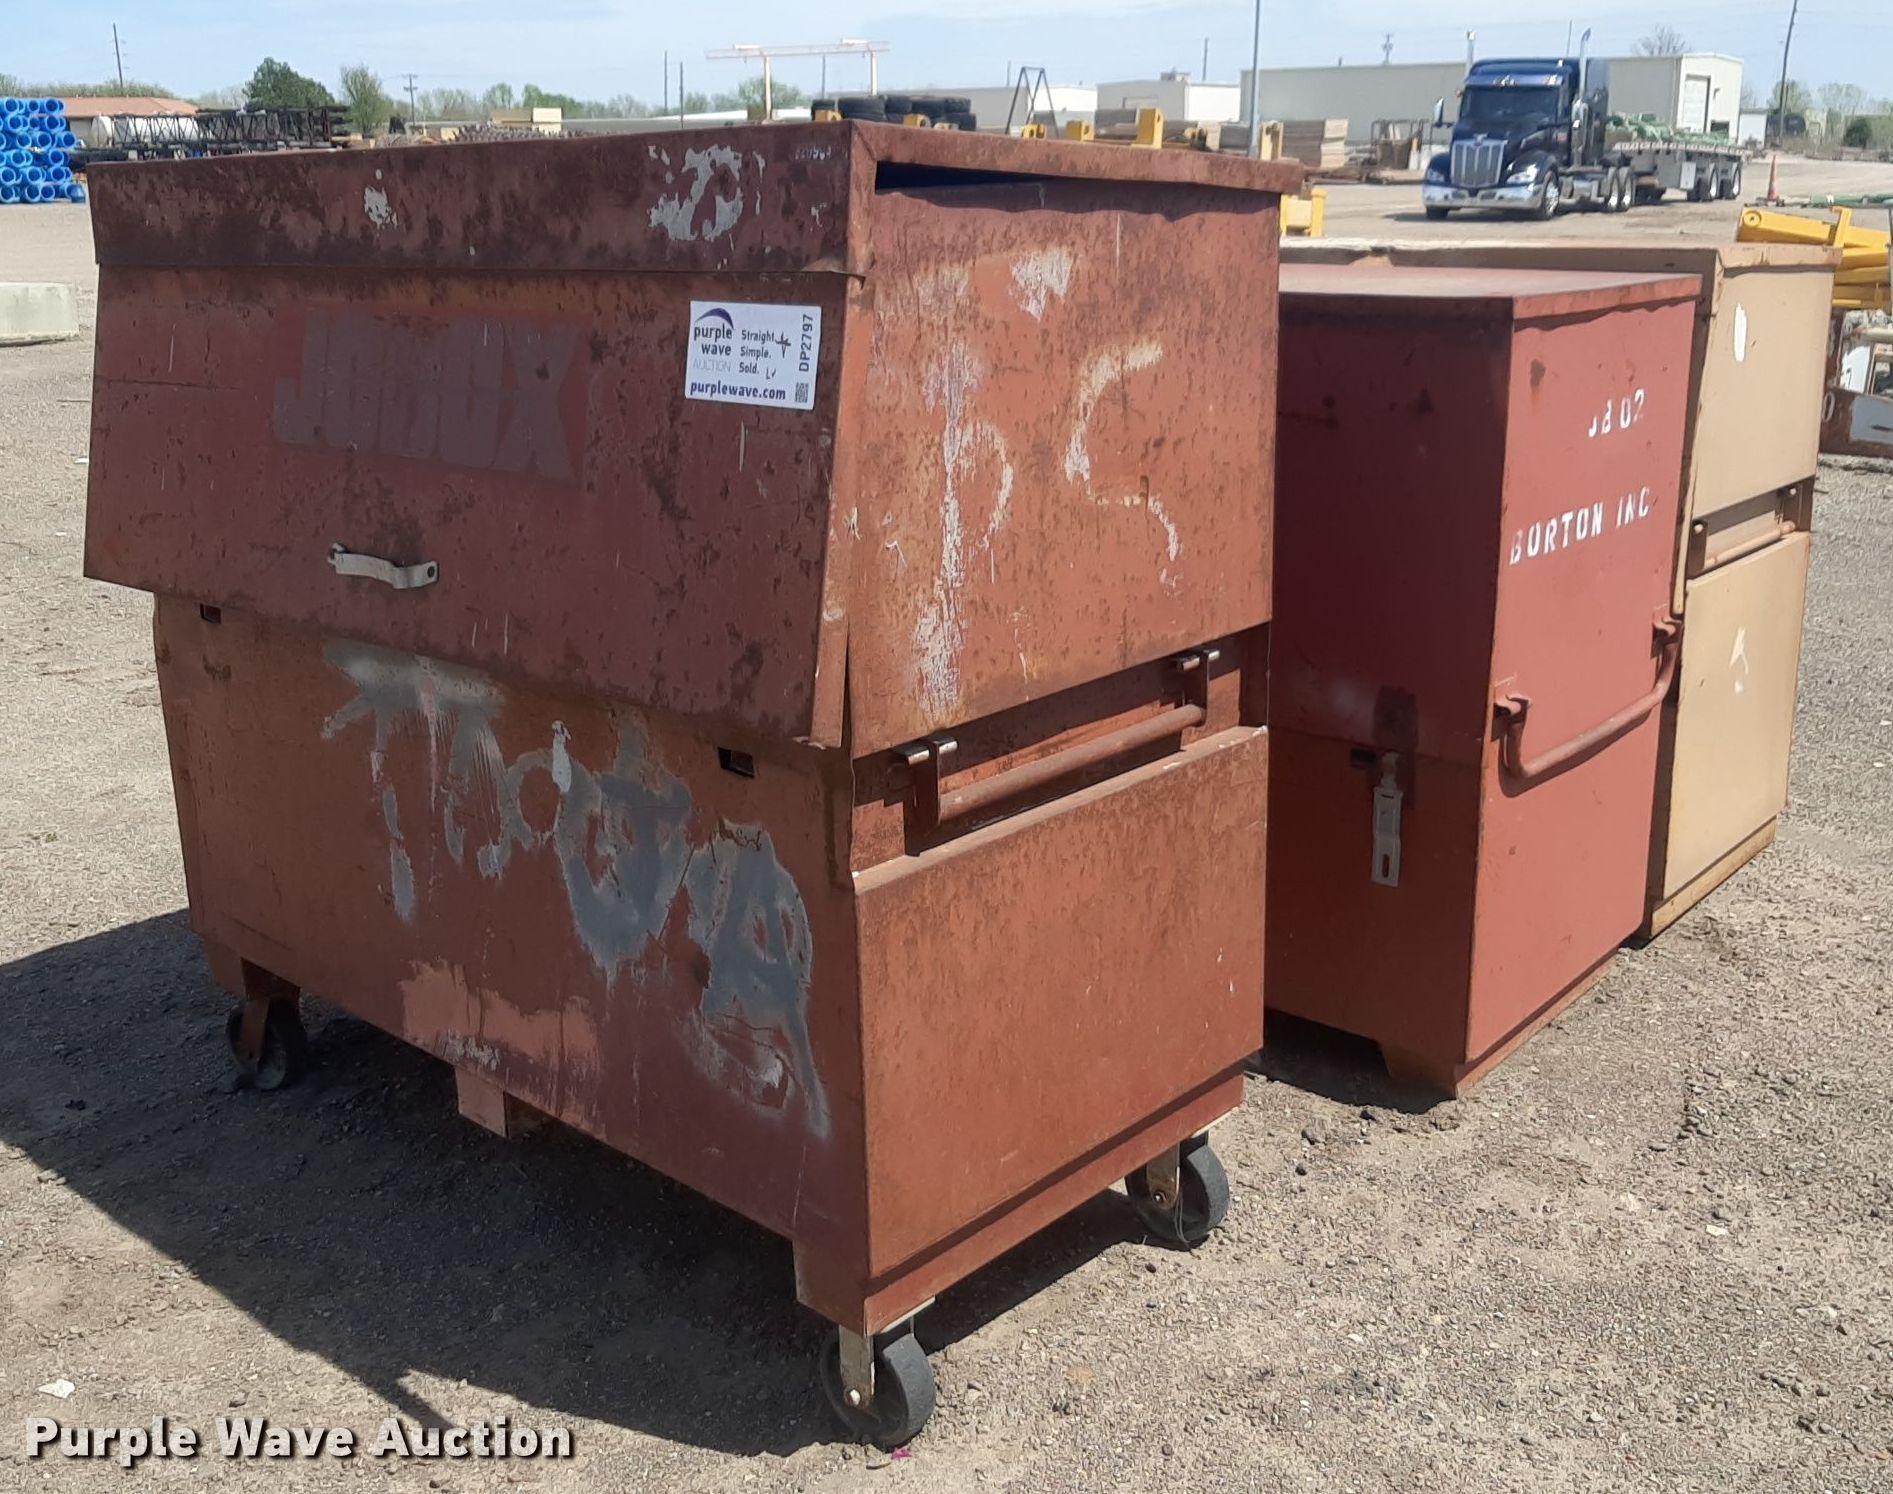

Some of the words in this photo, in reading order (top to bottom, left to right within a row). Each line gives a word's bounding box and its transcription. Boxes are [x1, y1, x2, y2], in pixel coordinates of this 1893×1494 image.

[693, 322, 733, 342] purple
[741, 329, 775, 345] Straight
[701, 343, 732, 357] wave
[799, 314, 814, 372] DP2797
[740, 345, 772, 361] Simple.
[692, 358, 732, 374] AUCTION
[738, 361, 760, 375] Sold.
[689, 379, 787, 400] purplewave.com
[1509, 502, 1604, 566] BURTON
[1615, 486, 1651, 529] INC
